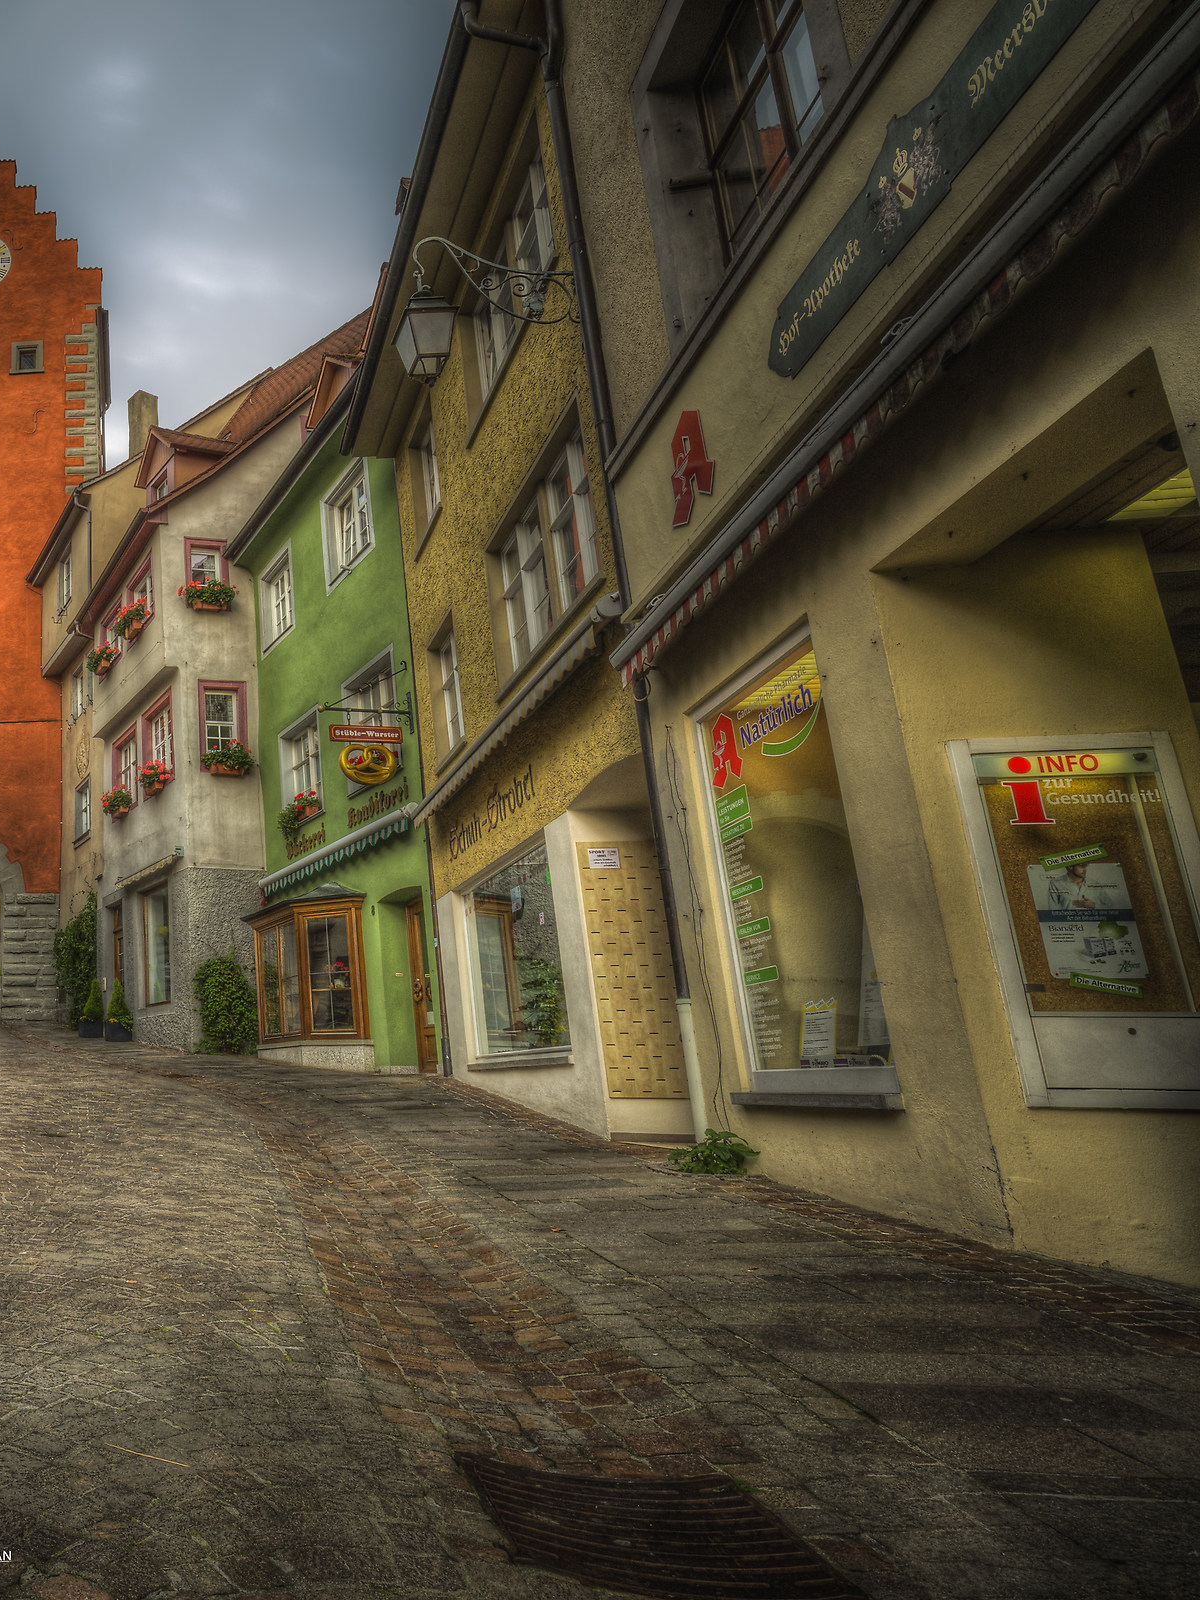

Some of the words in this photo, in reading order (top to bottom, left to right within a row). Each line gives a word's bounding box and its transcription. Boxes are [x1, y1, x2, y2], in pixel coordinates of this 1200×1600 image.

[968, 0, 1056, 109] Meersb
[779, 239, 861, 356] Hof-Apotheke
[739, 683, 813, 750] Natürlich
[335, 729, 399, 739] Stüble-Wurster
[1037, 754, 1099, 773] INFO
[1042, 777, 1072, 789] zur
[347, 776, 409, 828] Konditorei
[1046, 788, 1162, 805] Gesundheit!
[449, 763, 535, 863] Schuh-Strobel
[719, 798, 745, 816] LEISTUNGEN
[1046, 858, 1060, 866] Die
[1060, 848, 1100, 862] Alternative
[1076, 977, 1090, 985] Die
[1091, 979, 1137, 993] Alternative
